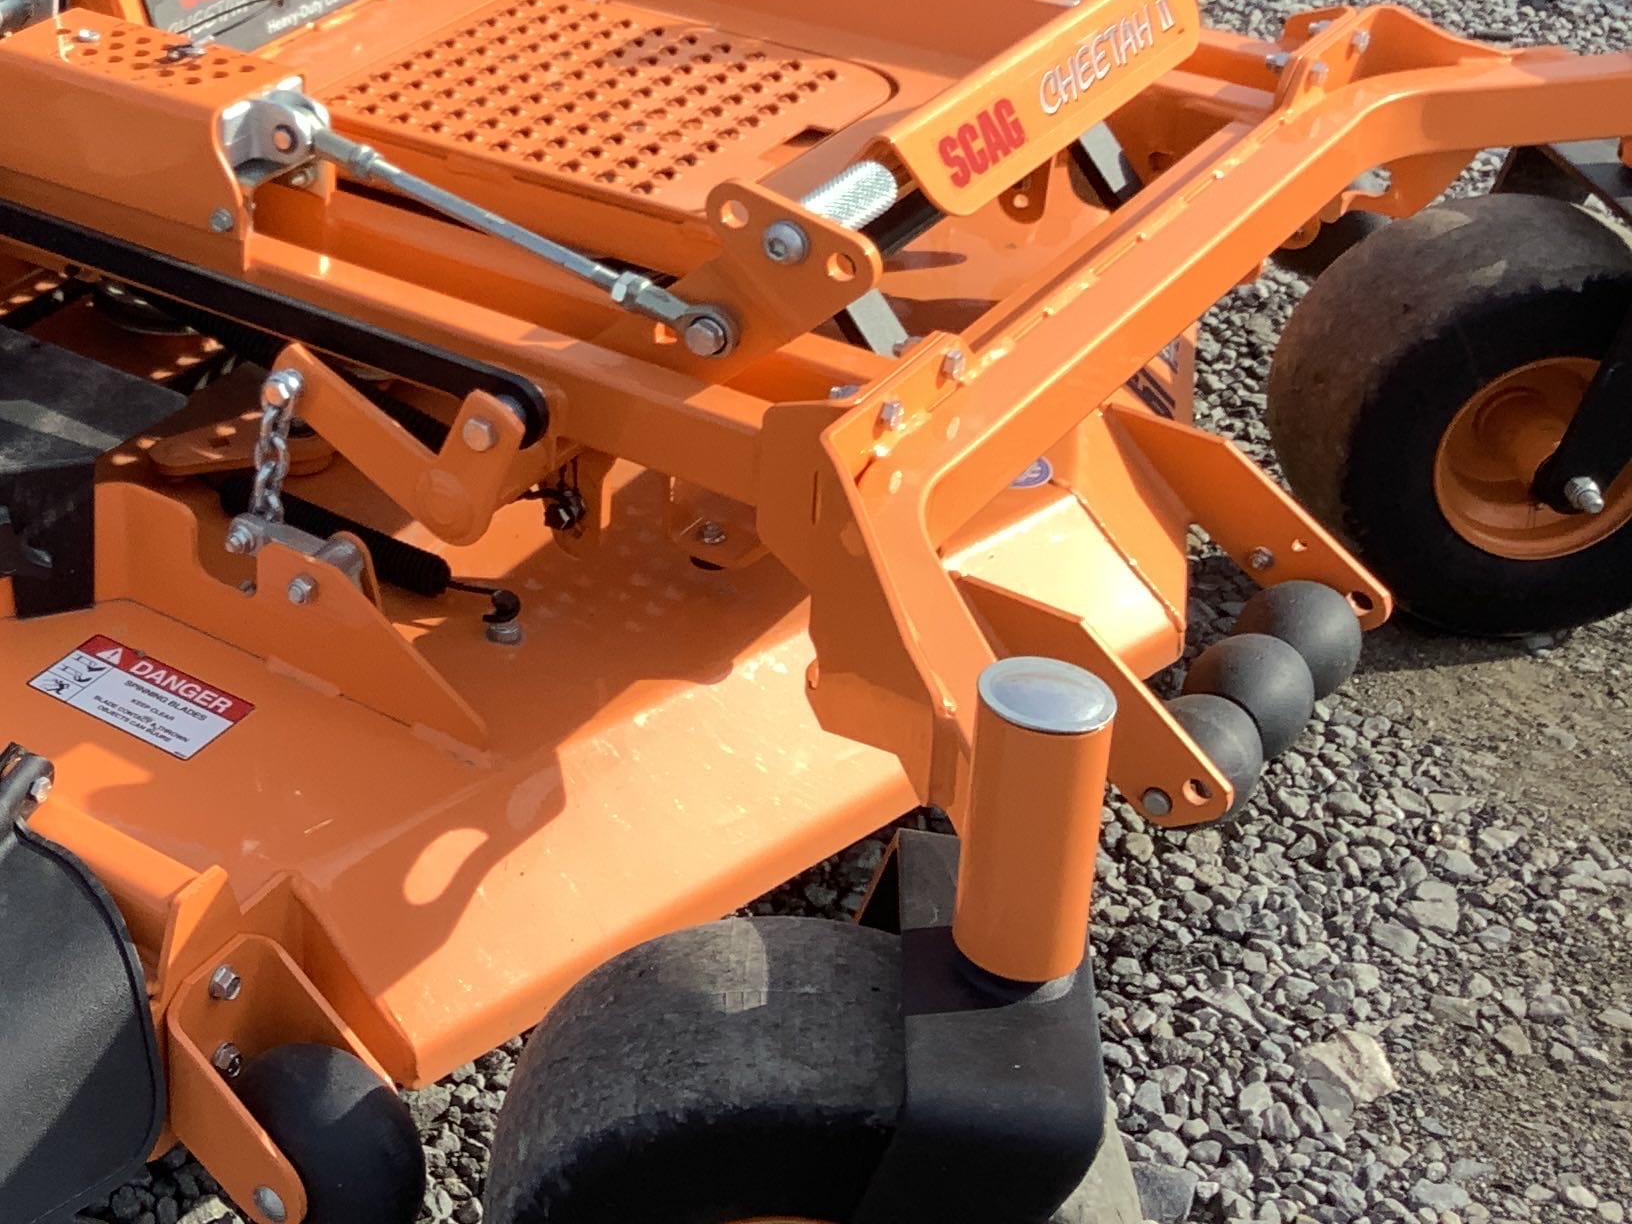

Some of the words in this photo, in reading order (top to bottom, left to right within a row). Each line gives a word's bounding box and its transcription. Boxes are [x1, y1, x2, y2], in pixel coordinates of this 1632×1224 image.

[267, 0, 323, 35] Heavy-Duty
[938, 98, 1027, 188] SCAG
[1039, 5, 1154, 115] CHEETAH
[124, 679, 169, 702] SPINNING
[167, 700, 207, 721] BLADES
[128, 660, 234, 713] DANGER
[130, 698, 150, 709] KEEP
[149, 707, 175, 721] CLEAR
